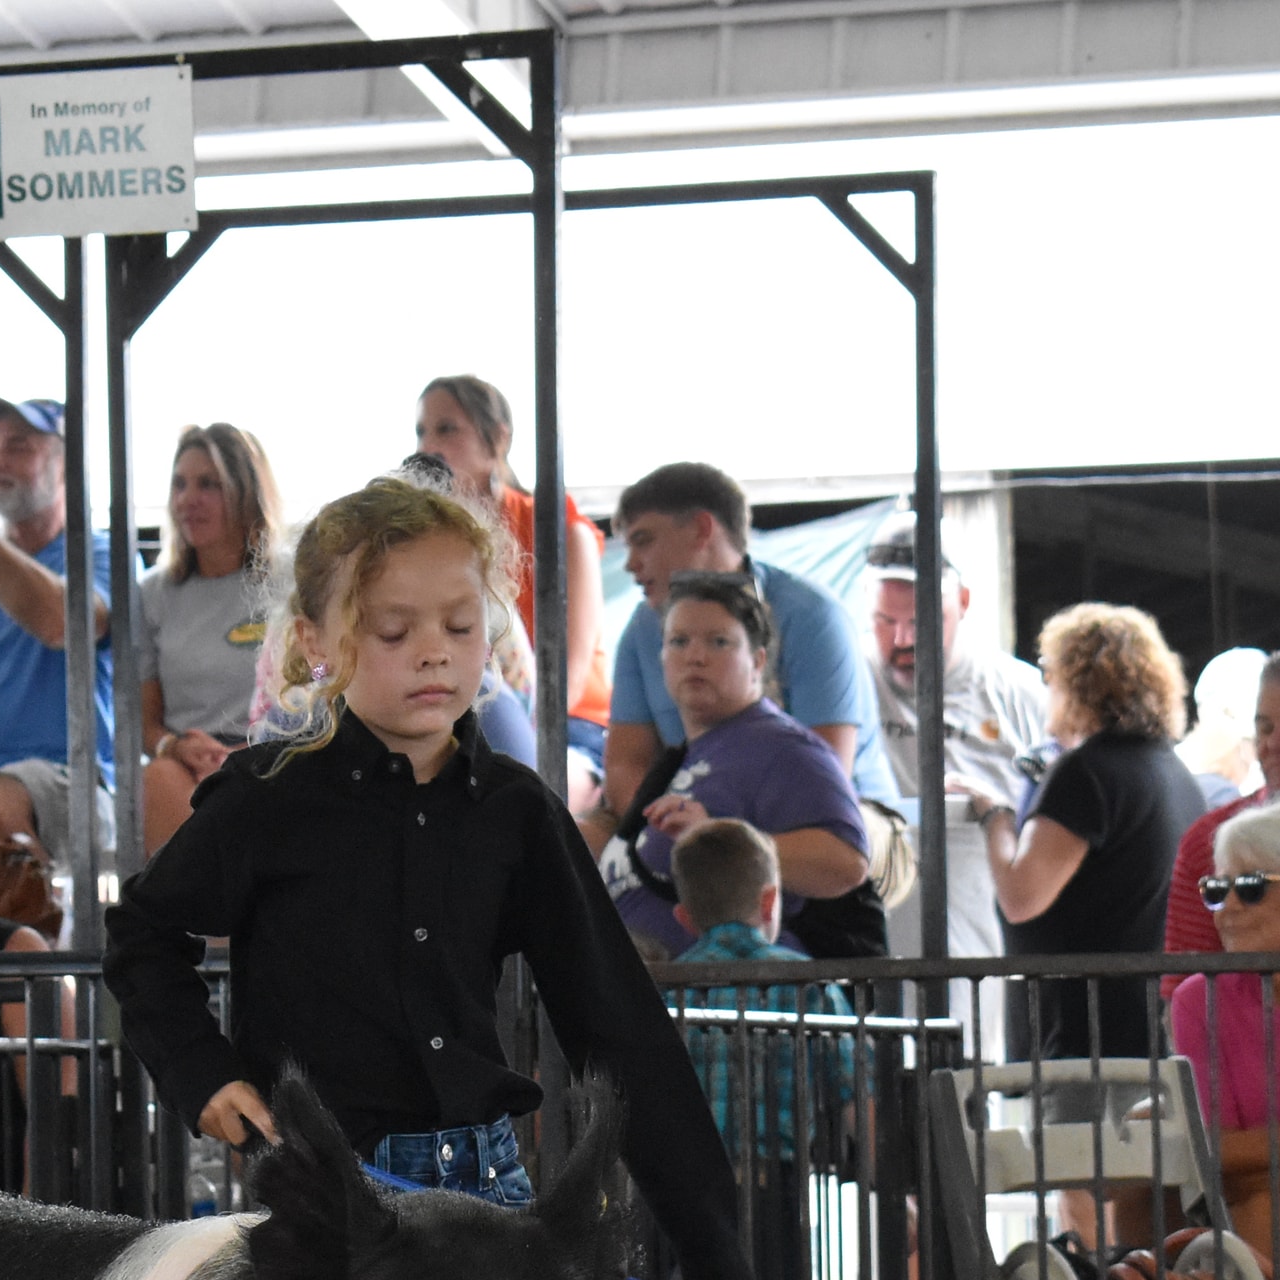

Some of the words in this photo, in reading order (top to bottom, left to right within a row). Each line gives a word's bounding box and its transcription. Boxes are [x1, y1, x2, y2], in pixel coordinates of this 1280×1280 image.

[30, 103, 48, 119] In
[53, 101, 127, 118] Memory
[132, 96, 152, 113] of
[43, 123, 147, 157] MARK
[6, 165, 187, 203] SOMMERS
